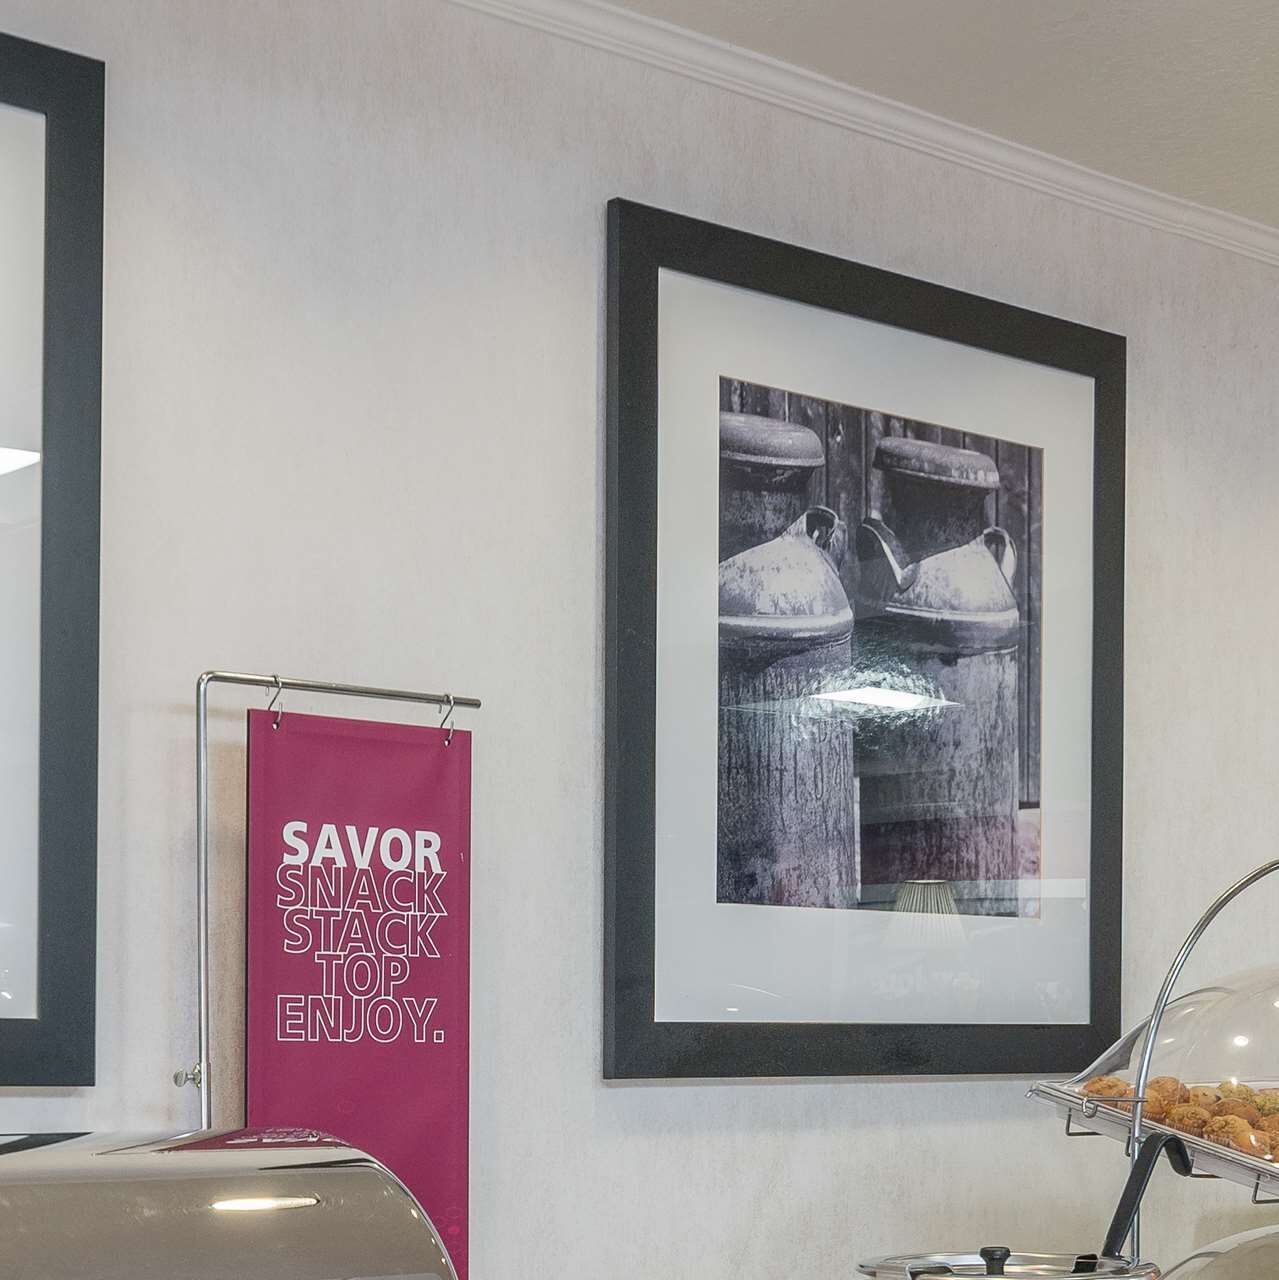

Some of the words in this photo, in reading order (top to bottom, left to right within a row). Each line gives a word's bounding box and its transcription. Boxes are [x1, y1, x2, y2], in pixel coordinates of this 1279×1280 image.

[283, 821, 442, 873] SAVOR
[276, 863, 448, 915] SNACK
[283, 906, 440, 957] STACK
[315, 952, 410, 1000] TOP
[277, 995, 445, 1043] ENJOY.
